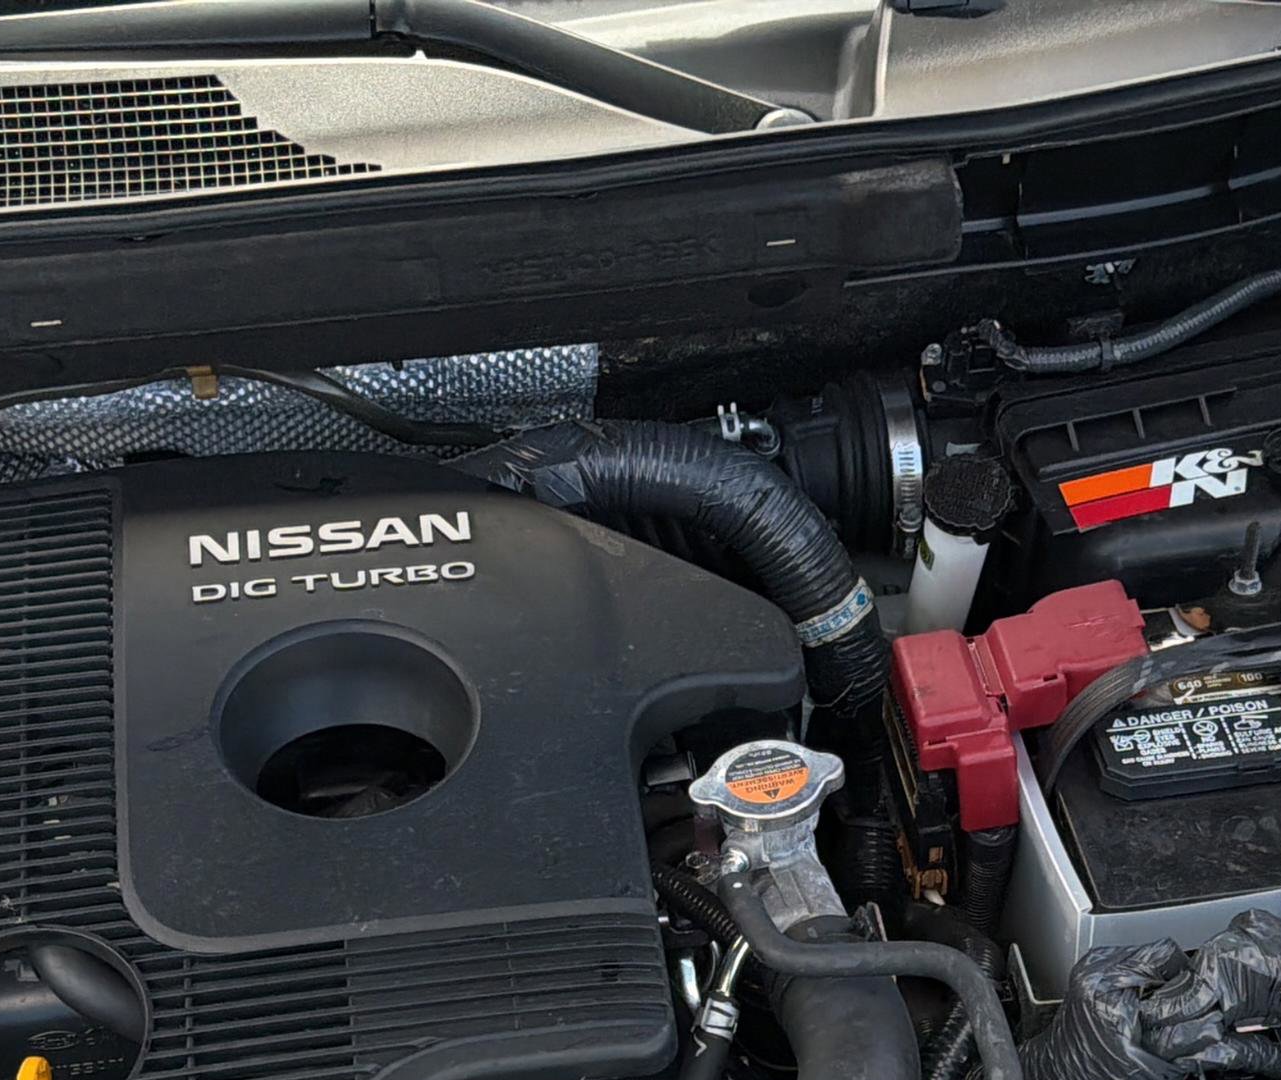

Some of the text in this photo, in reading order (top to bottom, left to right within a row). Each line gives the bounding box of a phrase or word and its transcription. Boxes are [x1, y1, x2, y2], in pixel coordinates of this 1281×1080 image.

[1149, 448, 1263, 508] K&N
[189, 511, 472, 566] NISSAN
[192, 561, 476, 602] DIG TURBO
[1127, 709, 1194, 727] DANGER
[1208, 700, 1269, 716] POISON
[746, 778, 795, 793] WARNING
